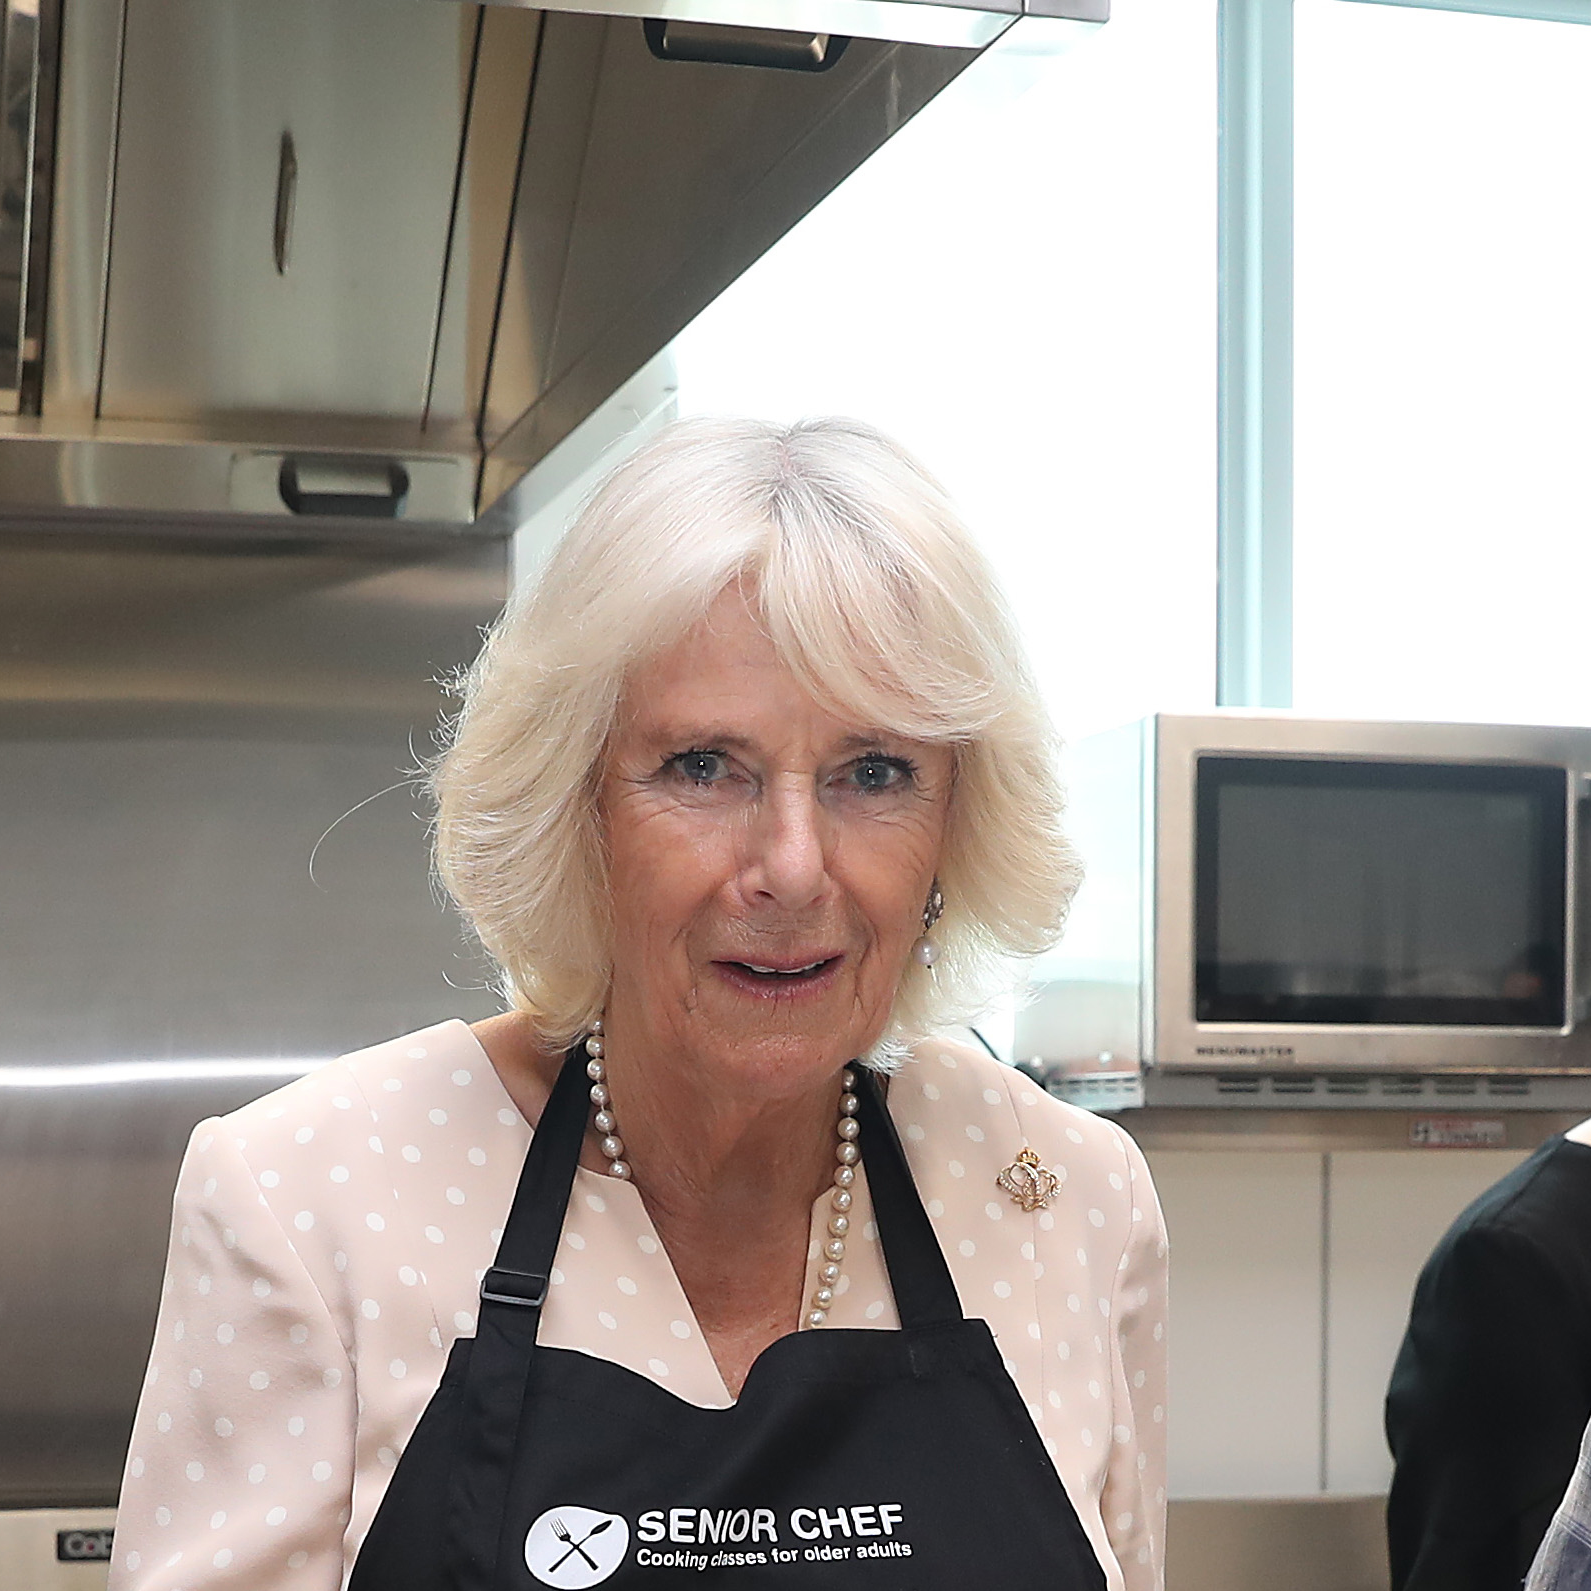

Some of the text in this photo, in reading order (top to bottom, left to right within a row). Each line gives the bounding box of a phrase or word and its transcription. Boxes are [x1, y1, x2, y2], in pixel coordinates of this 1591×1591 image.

[637, 1504, 903, 1544] SENIOR CHEF
[637, 1541, 912, 1570] Cooking classes for older adults
